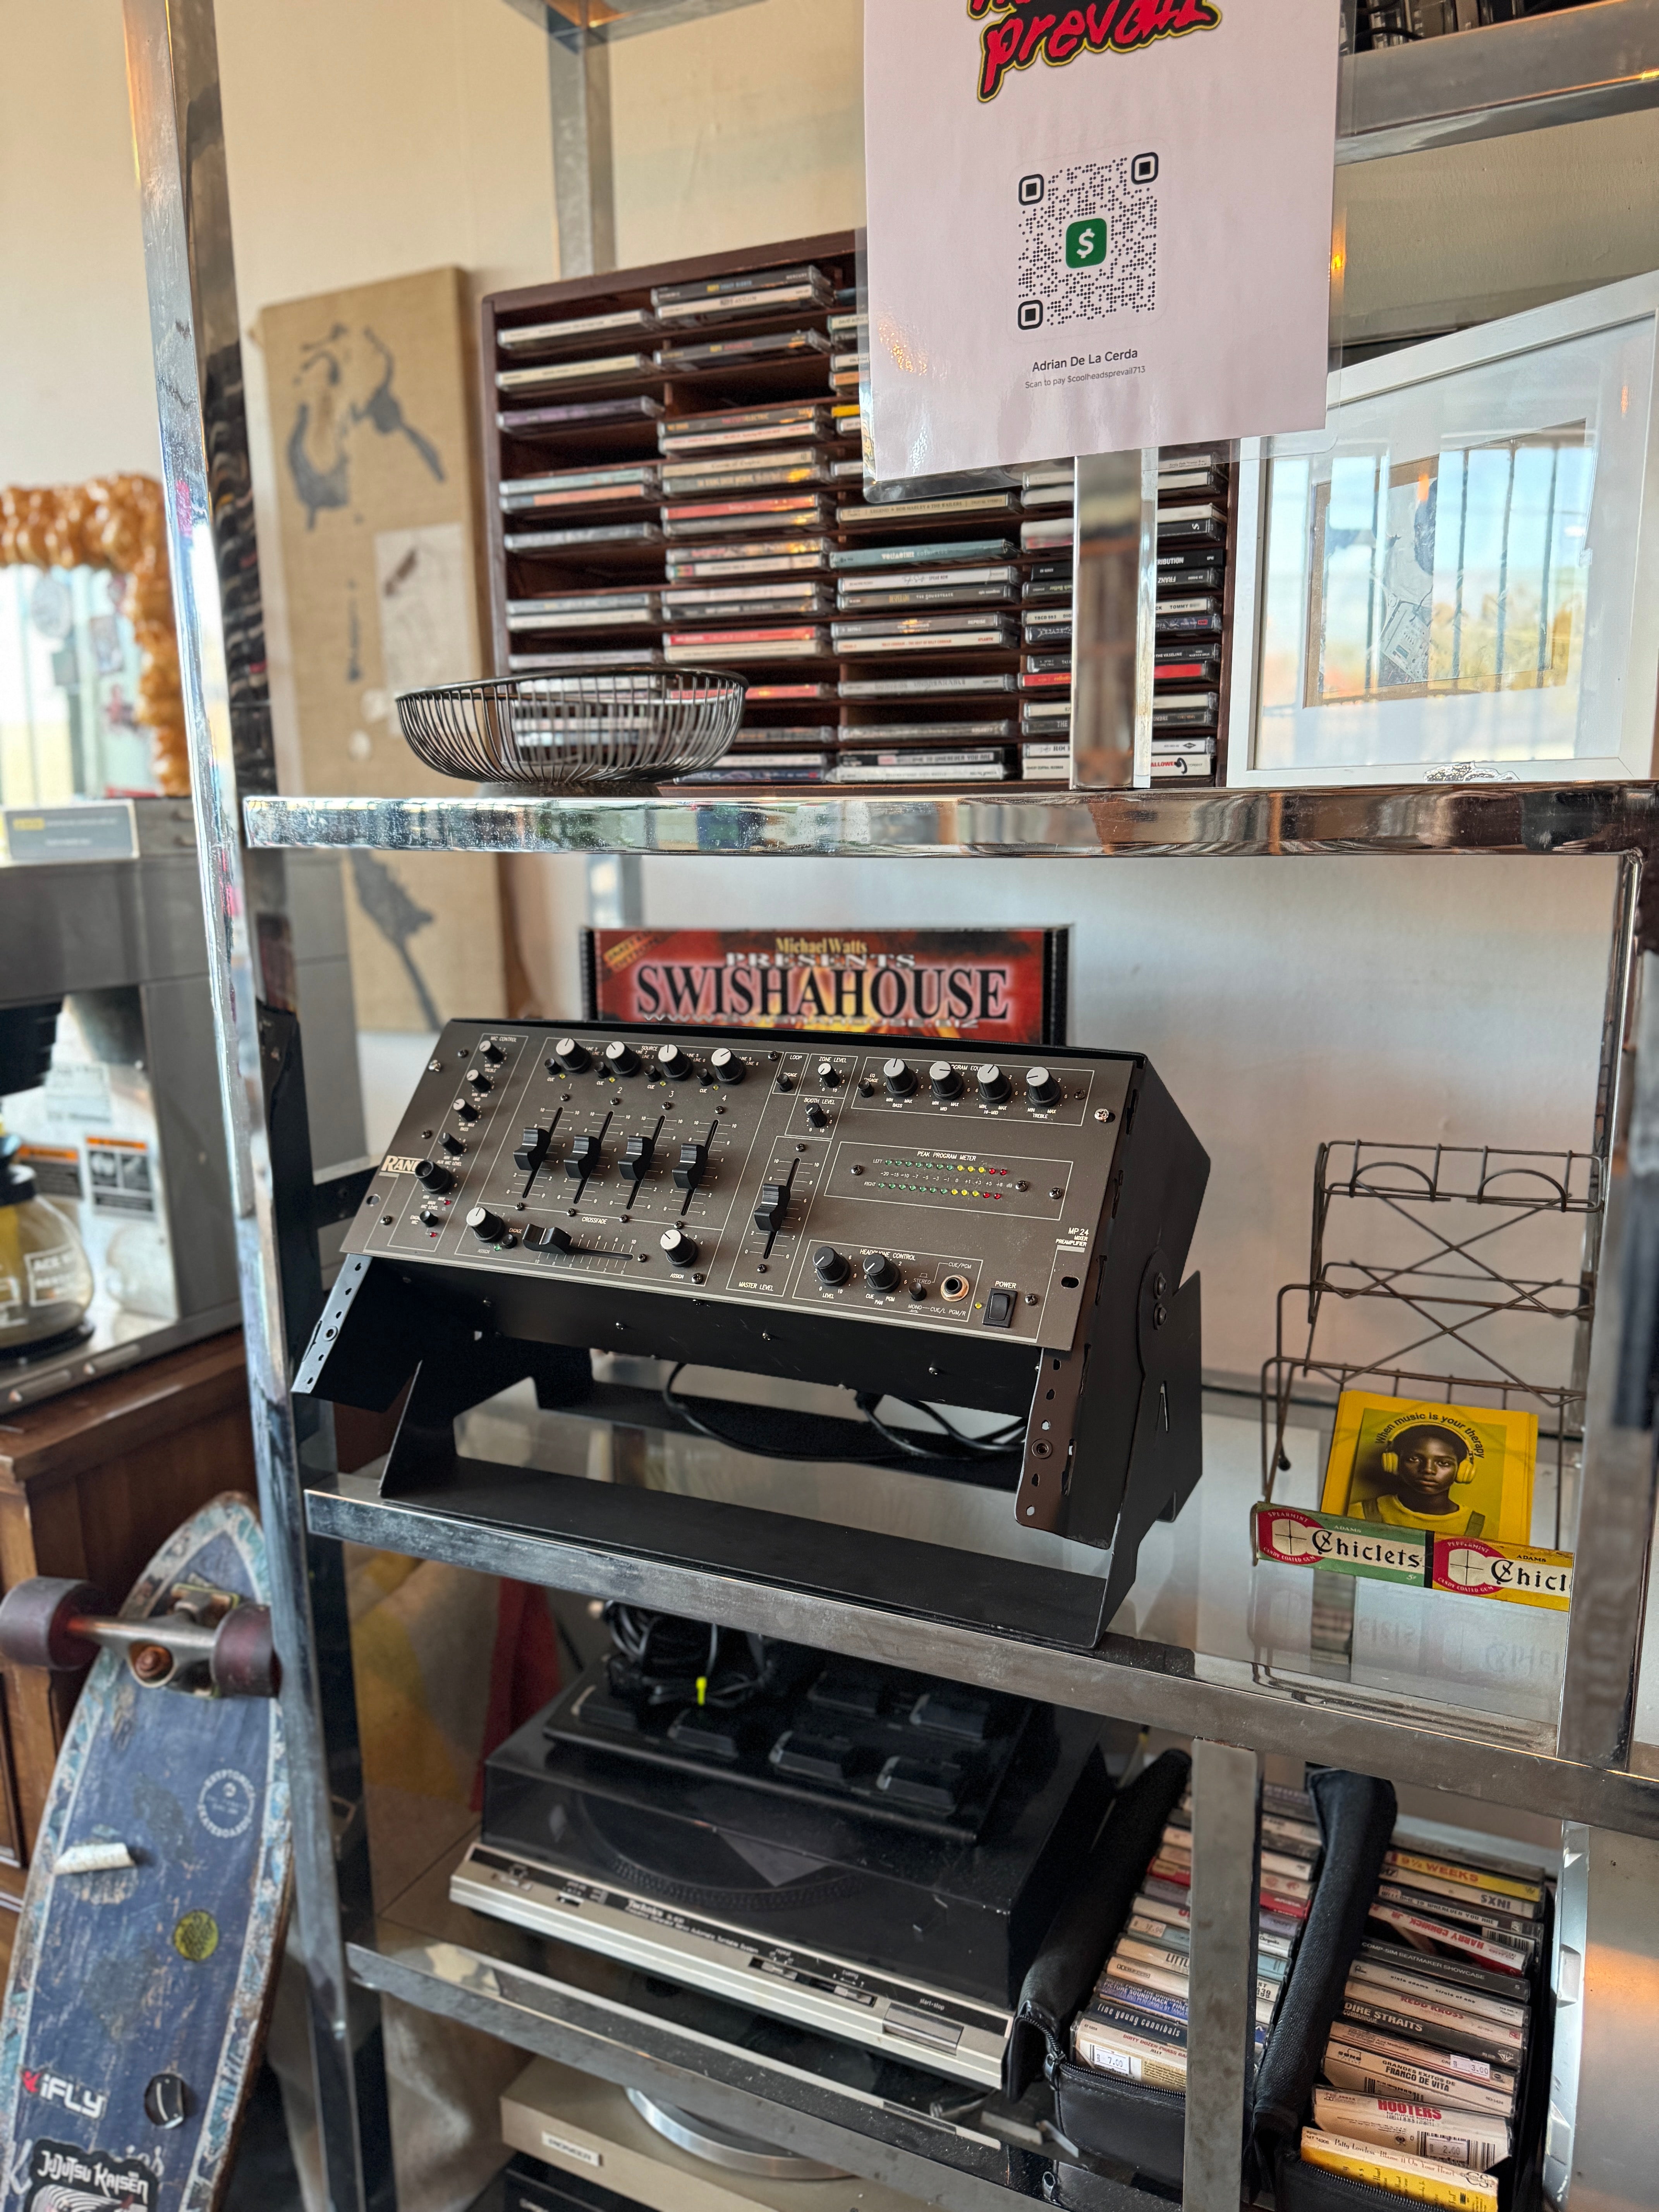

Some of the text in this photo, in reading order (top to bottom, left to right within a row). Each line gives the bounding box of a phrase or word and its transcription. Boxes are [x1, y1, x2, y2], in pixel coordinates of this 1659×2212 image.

[1032, 349, 1138, 372] Adrian De La Cerda
[1053, 378, 1065, 386] pay
[1067, 366, 1145, 383] $coolheadsprevail713
[934, 754, 965, 762] WHEREVER
[776, 937, 867, 955] Michael Watts
[726, 952, 916, 969] PRESENTS
[636, 965, 1008, 1021] SWISHAHOUSE
[582, 1216, 608, 1224] CROSSFADE
[1055, 1238, 1087, 1247] PREAMPLIFIER
[893, 1252, 916, 1261] CONTROL
[994, 1281, 1017, 1289] POWER
[1375, 1424, 1395, 1443] When
[1394, 1412, 1425, 1426] music
[1441, 1415, 1466, 1429] your
[1464, 1427, 1484, 1459] therapy
[1267, 1511, 1309, 1523] SPEARMINT
[1334, 1525, 1362, 1534] ADAMS
[1263, 1546, 1280, 1558] CANDY
[1281, 1554, 1302, 1563] COATED
[1312, 1529, 1420, 1568] Chiclets
[1448, 1541, 1490, 1553] PEPPERMINT
[1516, 1554, 1547, 1563] ADAMS
[1437, 1577, 1455, 1589] CANDY
[1491, 1559, 1571, 1592] Chicl
[1426, 1862, 1479, 1882] WEEKS
[1480, 1894, 1511, 1910] INXS
[1427, 1901, 1494, 1925] WHEREVER YOU ARE
[717, 1935, 739, 1948] Turntable
[740, 1942, 759, 1954] System
[1452, 1933, 1485, 1950] HARRY
[1165, 1953, 1189, 1967] LITTL
[1362, 1941, 1486, 1980] COMP-SIM BEATMAKER SHOWCASE
[1103, 1981, 1168, 2005] PICTURE SOUNDTRACK
[1408, 1979, 1429, 1989] adams
[1435, 1988, 1454, 1997] circle
[1400, 1995, 1464, 2020] REDD KROSS
[1097, 2003, 1181, 2037] fine young cannibals
[1343, 2009, 1378, 2025] COMMUNIQUE
[1344, 2002, 1424, 2033] DIRE STRAITS
[1123, 2033, 1139, 2043] DIRTY
[1140, 2039, 1158, 2049] DOZEN
[1108, 2056, 1123, 2068] 7.00
[1382, 2059, 1417, 2073] GRANDES
[1418, 2071, 1444, 2081] EXITOS
[1471, 2064, 1489, 2075] 3.00
[1385, 2066, 1449, 2092] FRANCO DE VITA
[40, 2074, 106, 2119] iFLY
[1377, 2099, 1442, 2121] HOOTERS
[1334, 2138, 1350, 2150] Patty
[1352, 2142, 1376, 2155] Loveless
[1380, 2150, 1399, 2162] Blame
[1408, 2157, 1418, 2167] On
[1420, 2160, 1436, 2171] Your
[1437, 2165, 1455, 2177] Heart
[38, 2149, 149, 2205] JUJUTSU KAISEN
